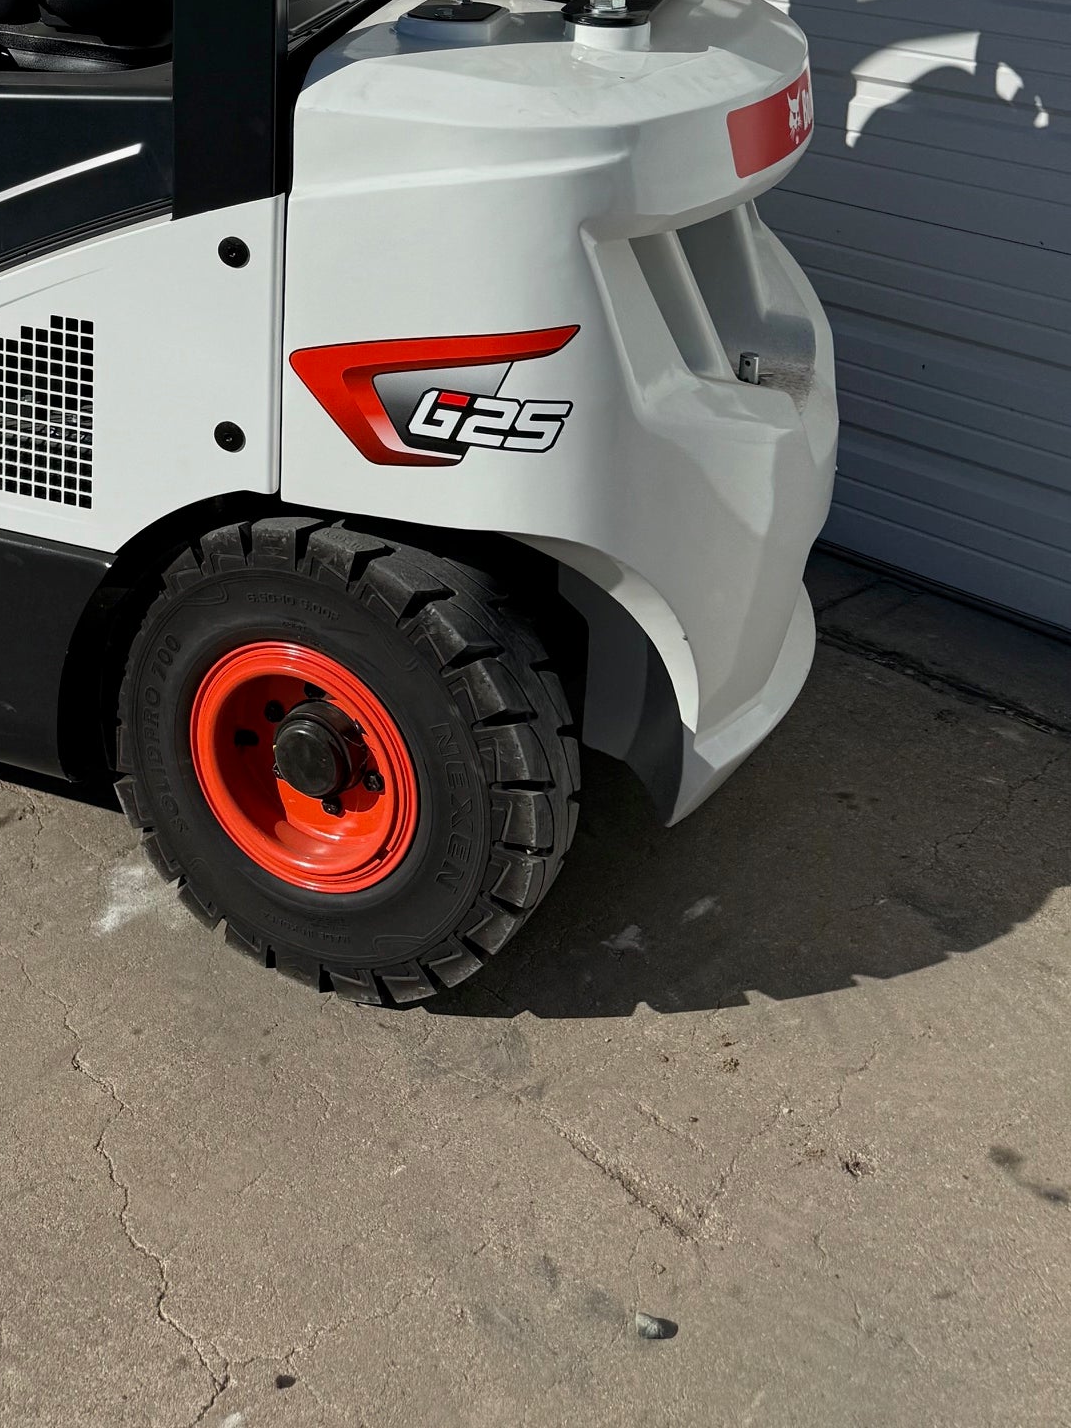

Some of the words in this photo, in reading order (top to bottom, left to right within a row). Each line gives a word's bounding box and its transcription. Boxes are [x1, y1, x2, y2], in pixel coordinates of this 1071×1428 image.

[408, 388, 573, 452] G25
[151, 633, 181, 682] 700
[143, 685, 189, 833] SOLIDPRO
[430, 722, 473, 894] NEXEN
